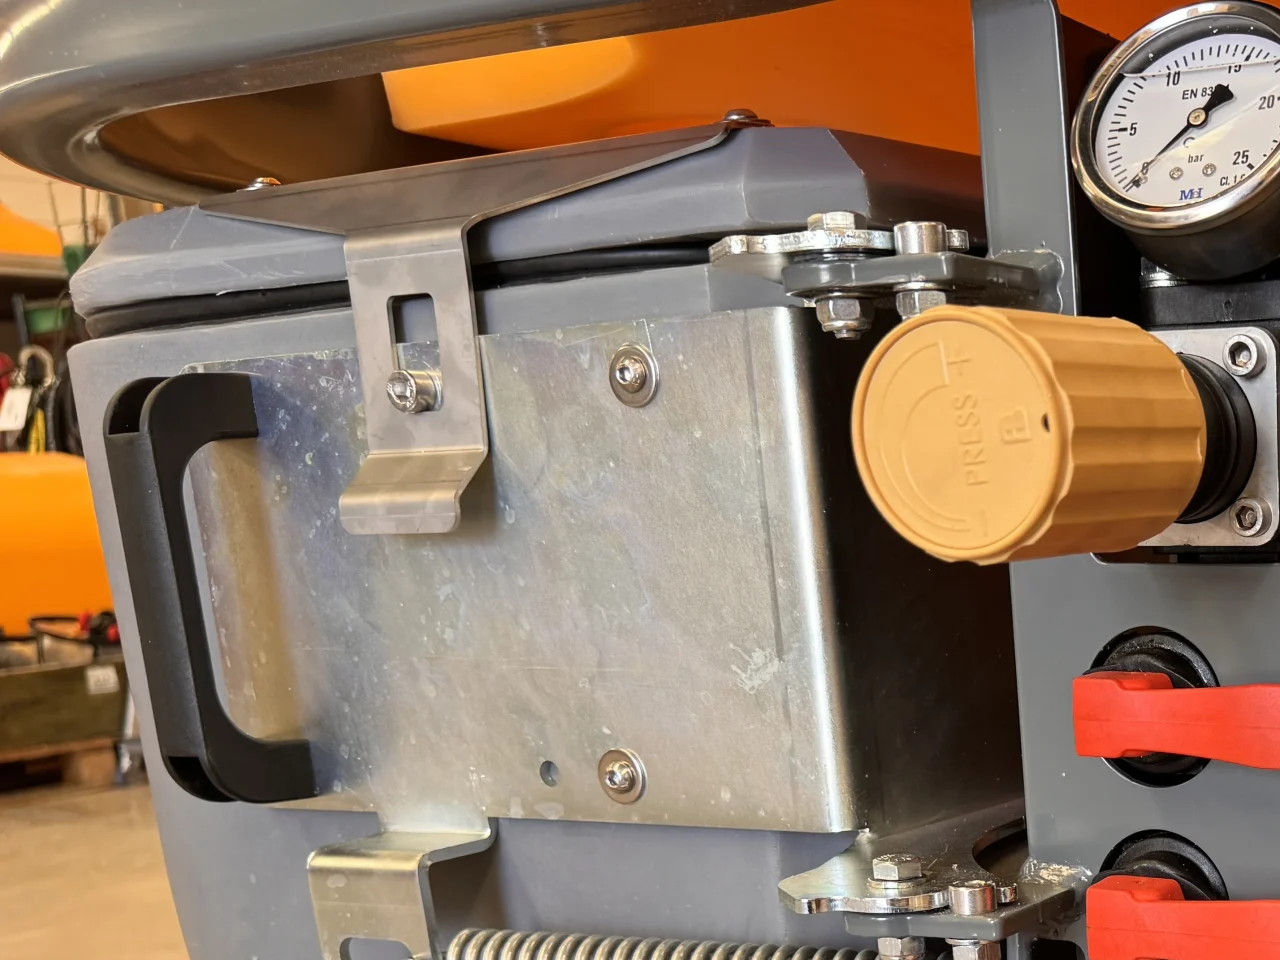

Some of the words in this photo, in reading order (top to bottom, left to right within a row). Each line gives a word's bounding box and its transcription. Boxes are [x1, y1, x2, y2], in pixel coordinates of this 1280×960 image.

[1166, 71, 1181, 86] 10
[1182, 88, 1198, 100] EN
[1258, 95, 1275, 110] 20
[1129, 123, 1137, 136] 5
[1188, 154, 1204, 163] bar
[1232, 150, 1249, 165] 25
[954, 394, 989, 487] PRESS
